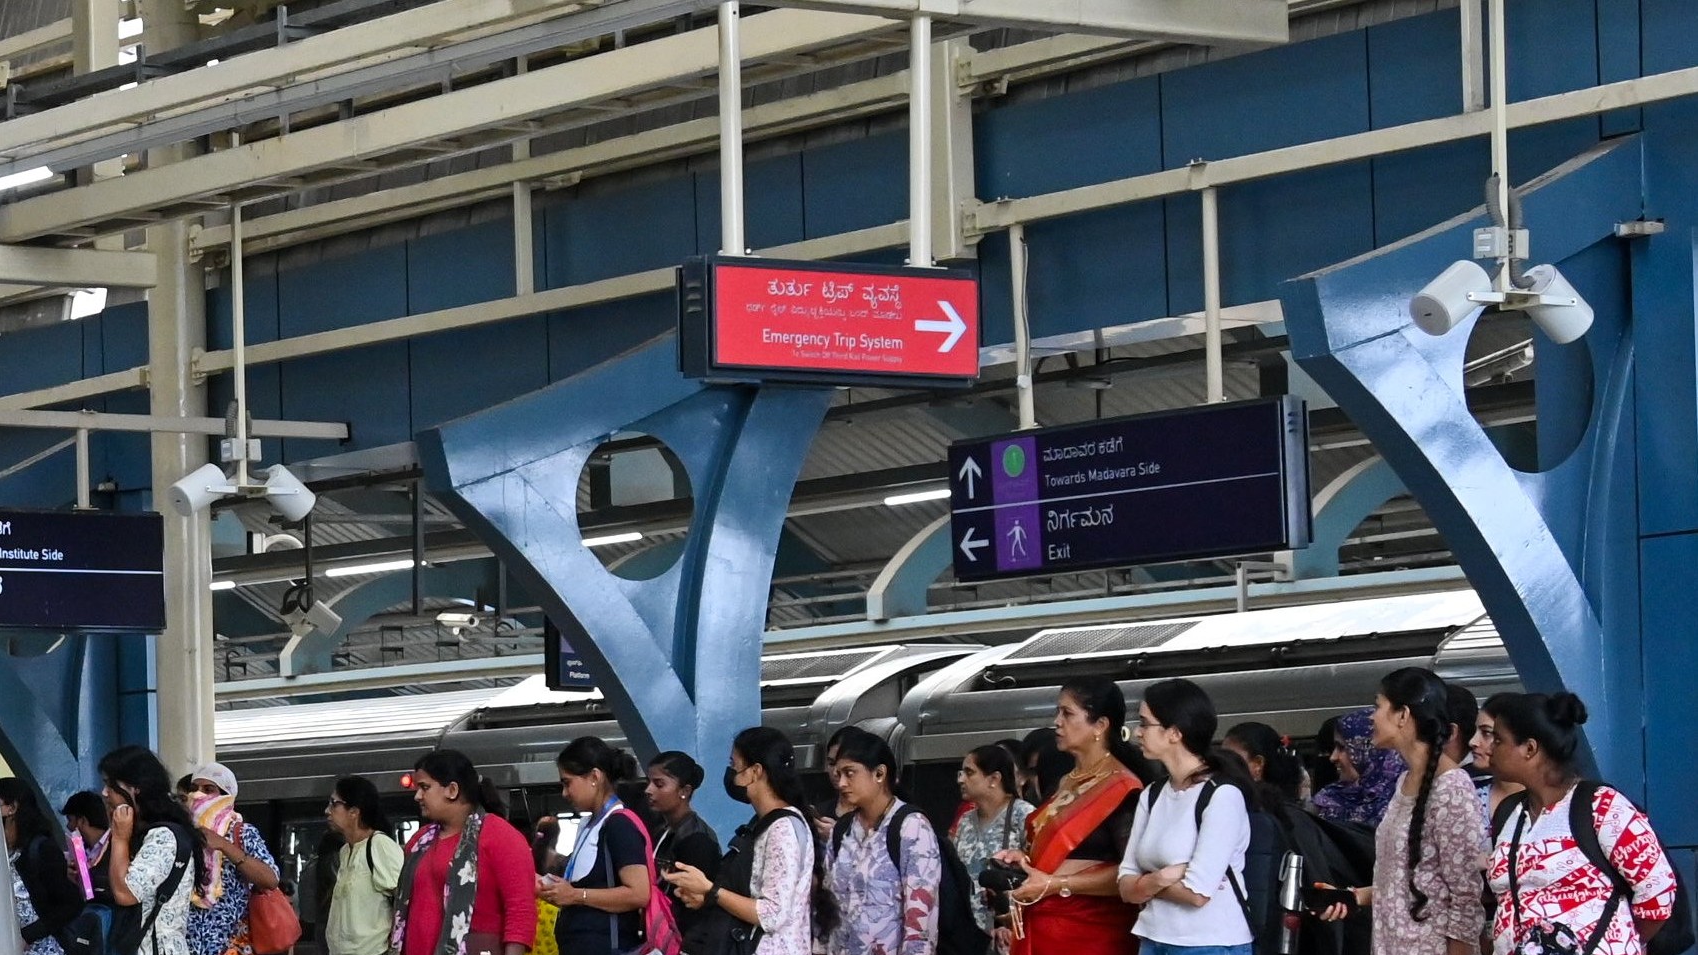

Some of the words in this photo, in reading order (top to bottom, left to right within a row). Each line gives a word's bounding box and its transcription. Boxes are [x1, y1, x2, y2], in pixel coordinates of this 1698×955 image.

[762, 328, 830, 348] Emergency
[833, 332, 856, 349] Trip
[859, 333, 903, 353] System
[1045, 471, 1087, 488] Towards
[1088, 466, 1137, 483] Madavara
[1139, 461, 1161, 476] Side
[1047, 503, 1115, 532] ನಿರ್ಗಮನ
[0, 547, 39, 560] Institute
[41, 548, 64, 561] Side
[1048, 543, 1071, 561] Exit
